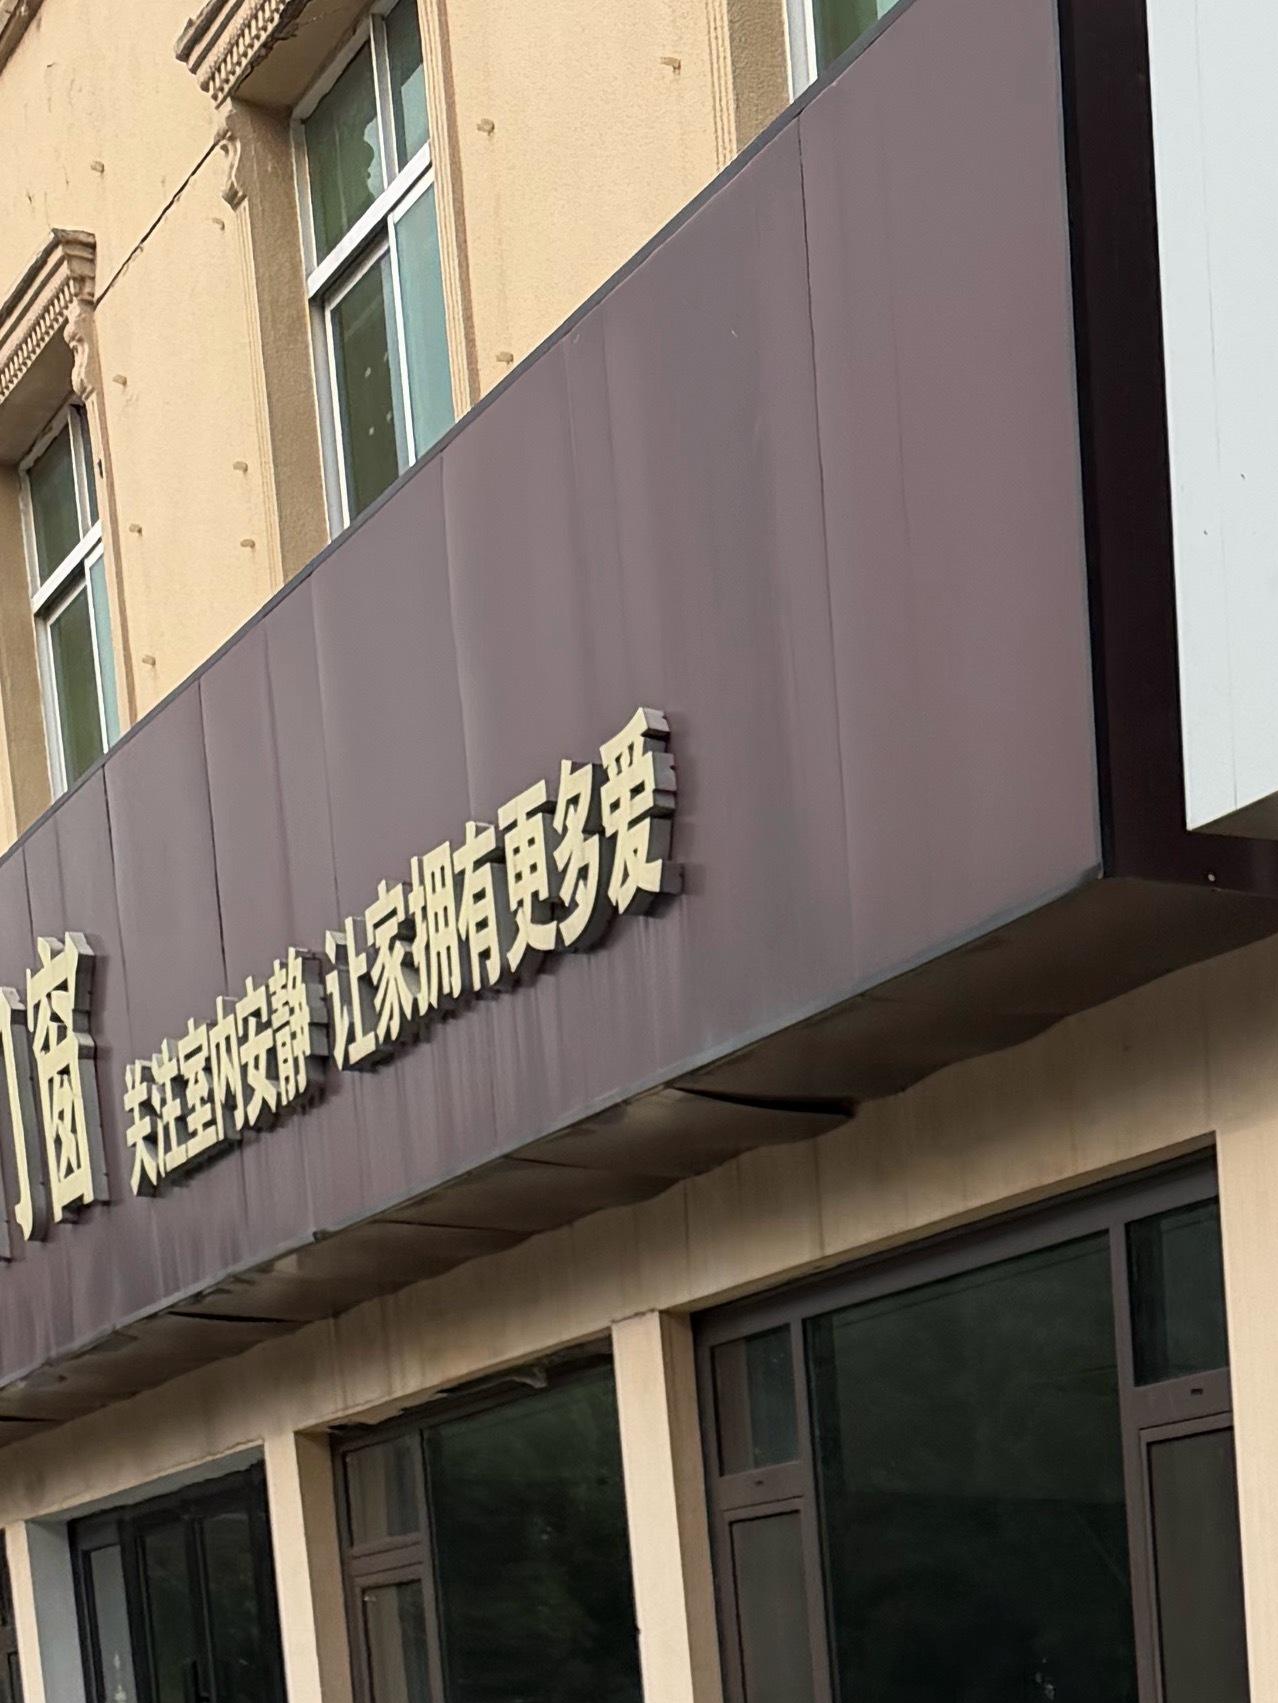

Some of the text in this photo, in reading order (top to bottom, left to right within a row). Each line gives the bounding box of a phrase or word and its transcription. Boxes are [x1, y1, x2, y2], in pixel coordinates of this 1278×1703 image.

[123, 706, 662, 1196] 关注室内安静 让家拥有更多爱
